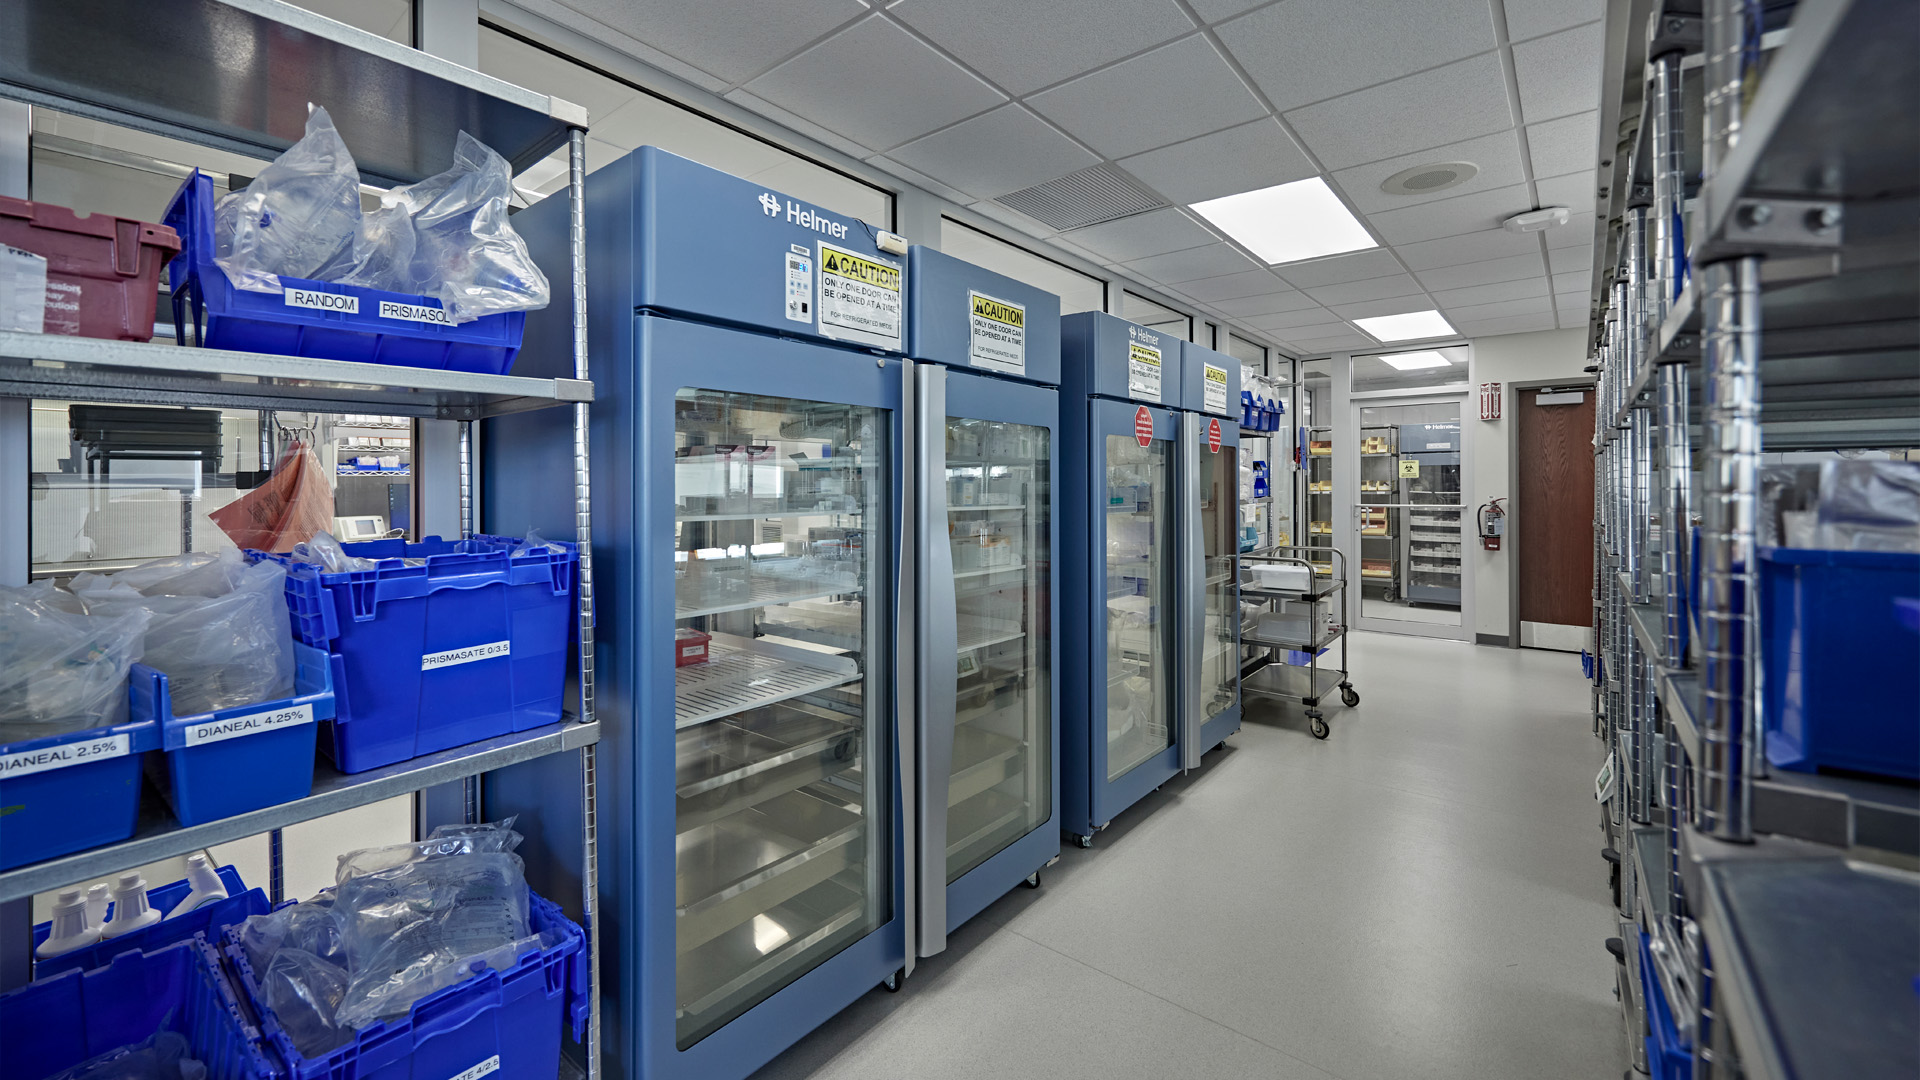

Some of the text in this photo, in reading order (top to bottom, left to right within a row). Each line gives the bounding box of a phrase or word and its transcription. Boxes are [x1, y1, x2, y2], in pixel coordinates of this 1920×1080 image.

[786, 200, 849, 240] Helmer
[840, 257, 897, 288] CAUTION
[824, 277, 897, 303] ONLY ONE DOOR CAN
[294, 291, 355, 311] RANDOM
[824, 288, 897, 314] BE OPENED AT A TIME
[382, 303, 451, 324] PRISMASOL
[830, 310, 841, 318] FOR
[842, 314, 879, 327] REFRIGERATED
[984, 302, 1022, 325] CAUTION
[974, 319, 987, 328] ONLY
[988, 322, 998, 332] ONE
[974, 328, 981, 336] BE
[982, 330, 1001, 341] OPENED
[1137, 328, 1159, 346] Helmer
[1210, 367, 1226, 382] CAUTION
[422, 644, 508, 666] PRISMASATE 0/3.5
[197, 710, 304, 739] DIANEAL 4.25%
[76, 740, 117, 757] 2.5%
[476, 1058, 499, 1074] 4/2.5
